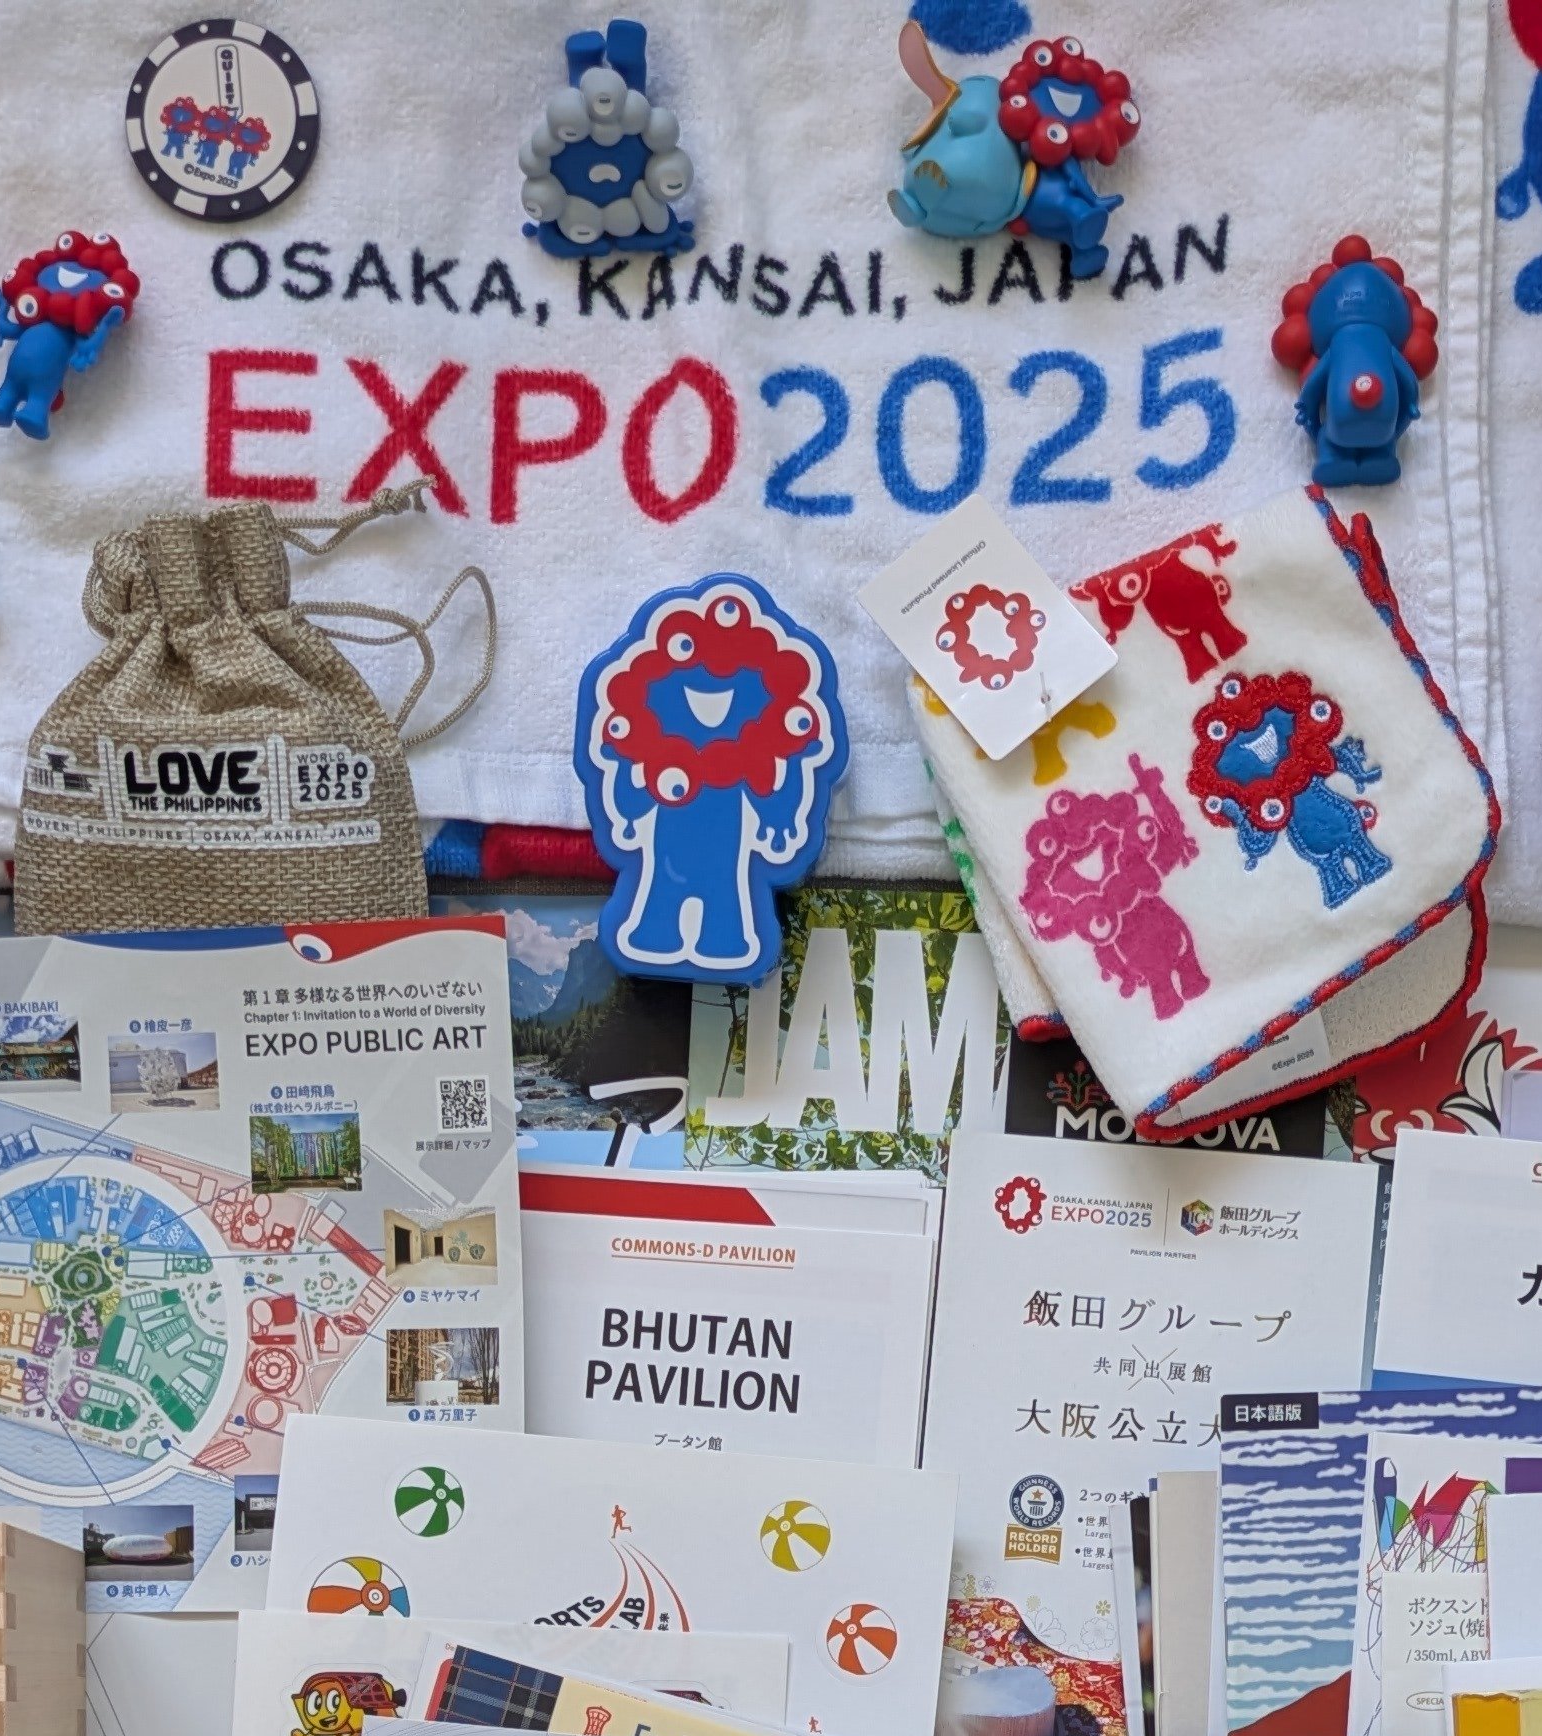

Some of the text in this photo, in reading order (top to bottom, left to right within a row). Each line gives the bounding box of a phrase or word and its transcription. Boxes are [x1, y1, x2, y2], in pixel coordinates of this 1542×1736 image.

[211, 240, 549, 326] OSAKA,
[577, 243, 909, 320] KANSAI,
[205, 327, 1238, 525] EXPO2025
[124, 750, 260, 796] LOVE
[129, 797, 263, 814] THE PHILIPPINES
[243, 1010, 290, 1027] Chapter
[302, 1008, 356, 1022] Invitation
[358, 1008, 371, 1020] to
[383, 1005, 418, 1019] World
[420, 1004, 432, 1018] of
[433, 1002, 487, 1020] Diversity
[245, 1025, 487, 1058] EXPO PUBLIC ART
[1055, 1106, 1280, 1152] MOOVA
[1050, 1204, 1153, 1230] EXPO2025
[611, 1236, 797, 1265] COMMONS-D PAVILION
[1022, 1289, 1292, 1344] 飯田グループ
[601, 1306, 793, 1361] BHUTAN
[1092, 1355, 1214, 1385] 共同出展館
[585, 1359, 801, 1414] PAVILION
[1233, 1401, 1303, 1422] 日本語版
[653, 1432, 723, 1453] ブータン館
[1008, 1530, 1059, 1545] RECORD
